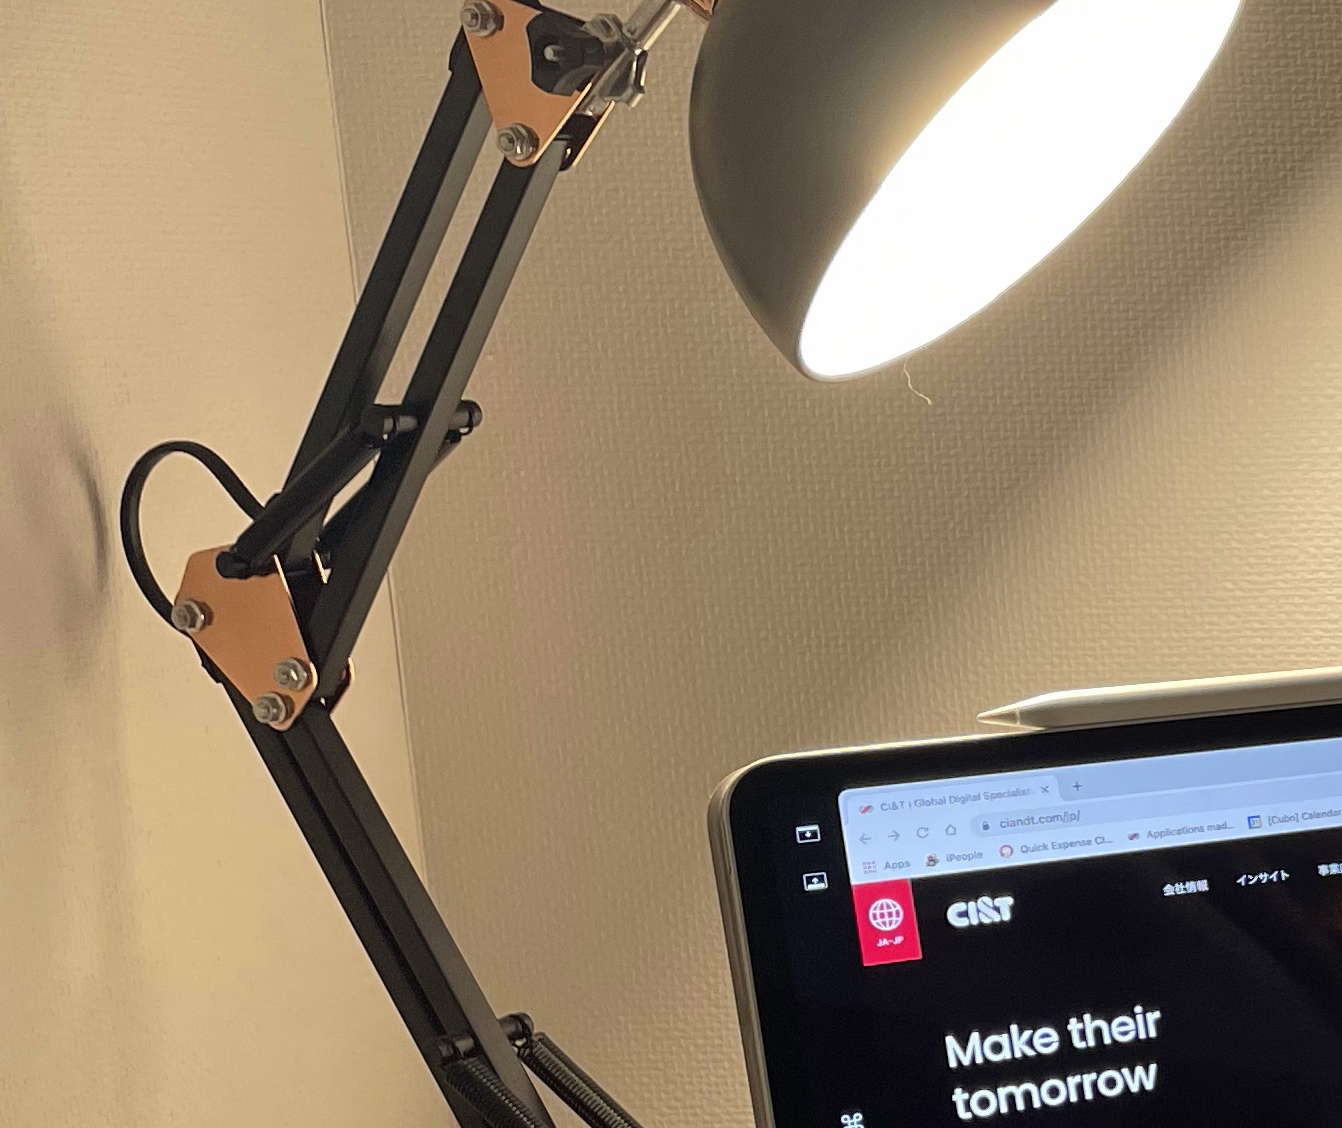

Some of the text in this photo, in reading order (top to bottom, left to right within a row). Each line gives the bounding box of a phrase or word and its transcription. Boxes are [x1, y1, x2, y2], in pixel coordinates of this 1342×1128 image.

[914, 797, 947, 809] Global
[949, 793, 981, 806] Digital
[999, 810, 1081, 829] ciandt.com/jp/
[1301, 809, 1342, 821] Calendar
[1146, 825, 1204, 840] Applications
[1020, 842, 1050, 854] Quick
[1051, 839, 1092, 851] Expense
[884, 859, 911, 872] Apps
[1236, 869, 1290, 886] インサイト
[1162, 879, 1209, 897] 会社情報
[947, 896, 1014, 928] CI&T
[945, 1004, 1162, 1069] Make their
[952, 1063, 1158, 1120] tomorrow
